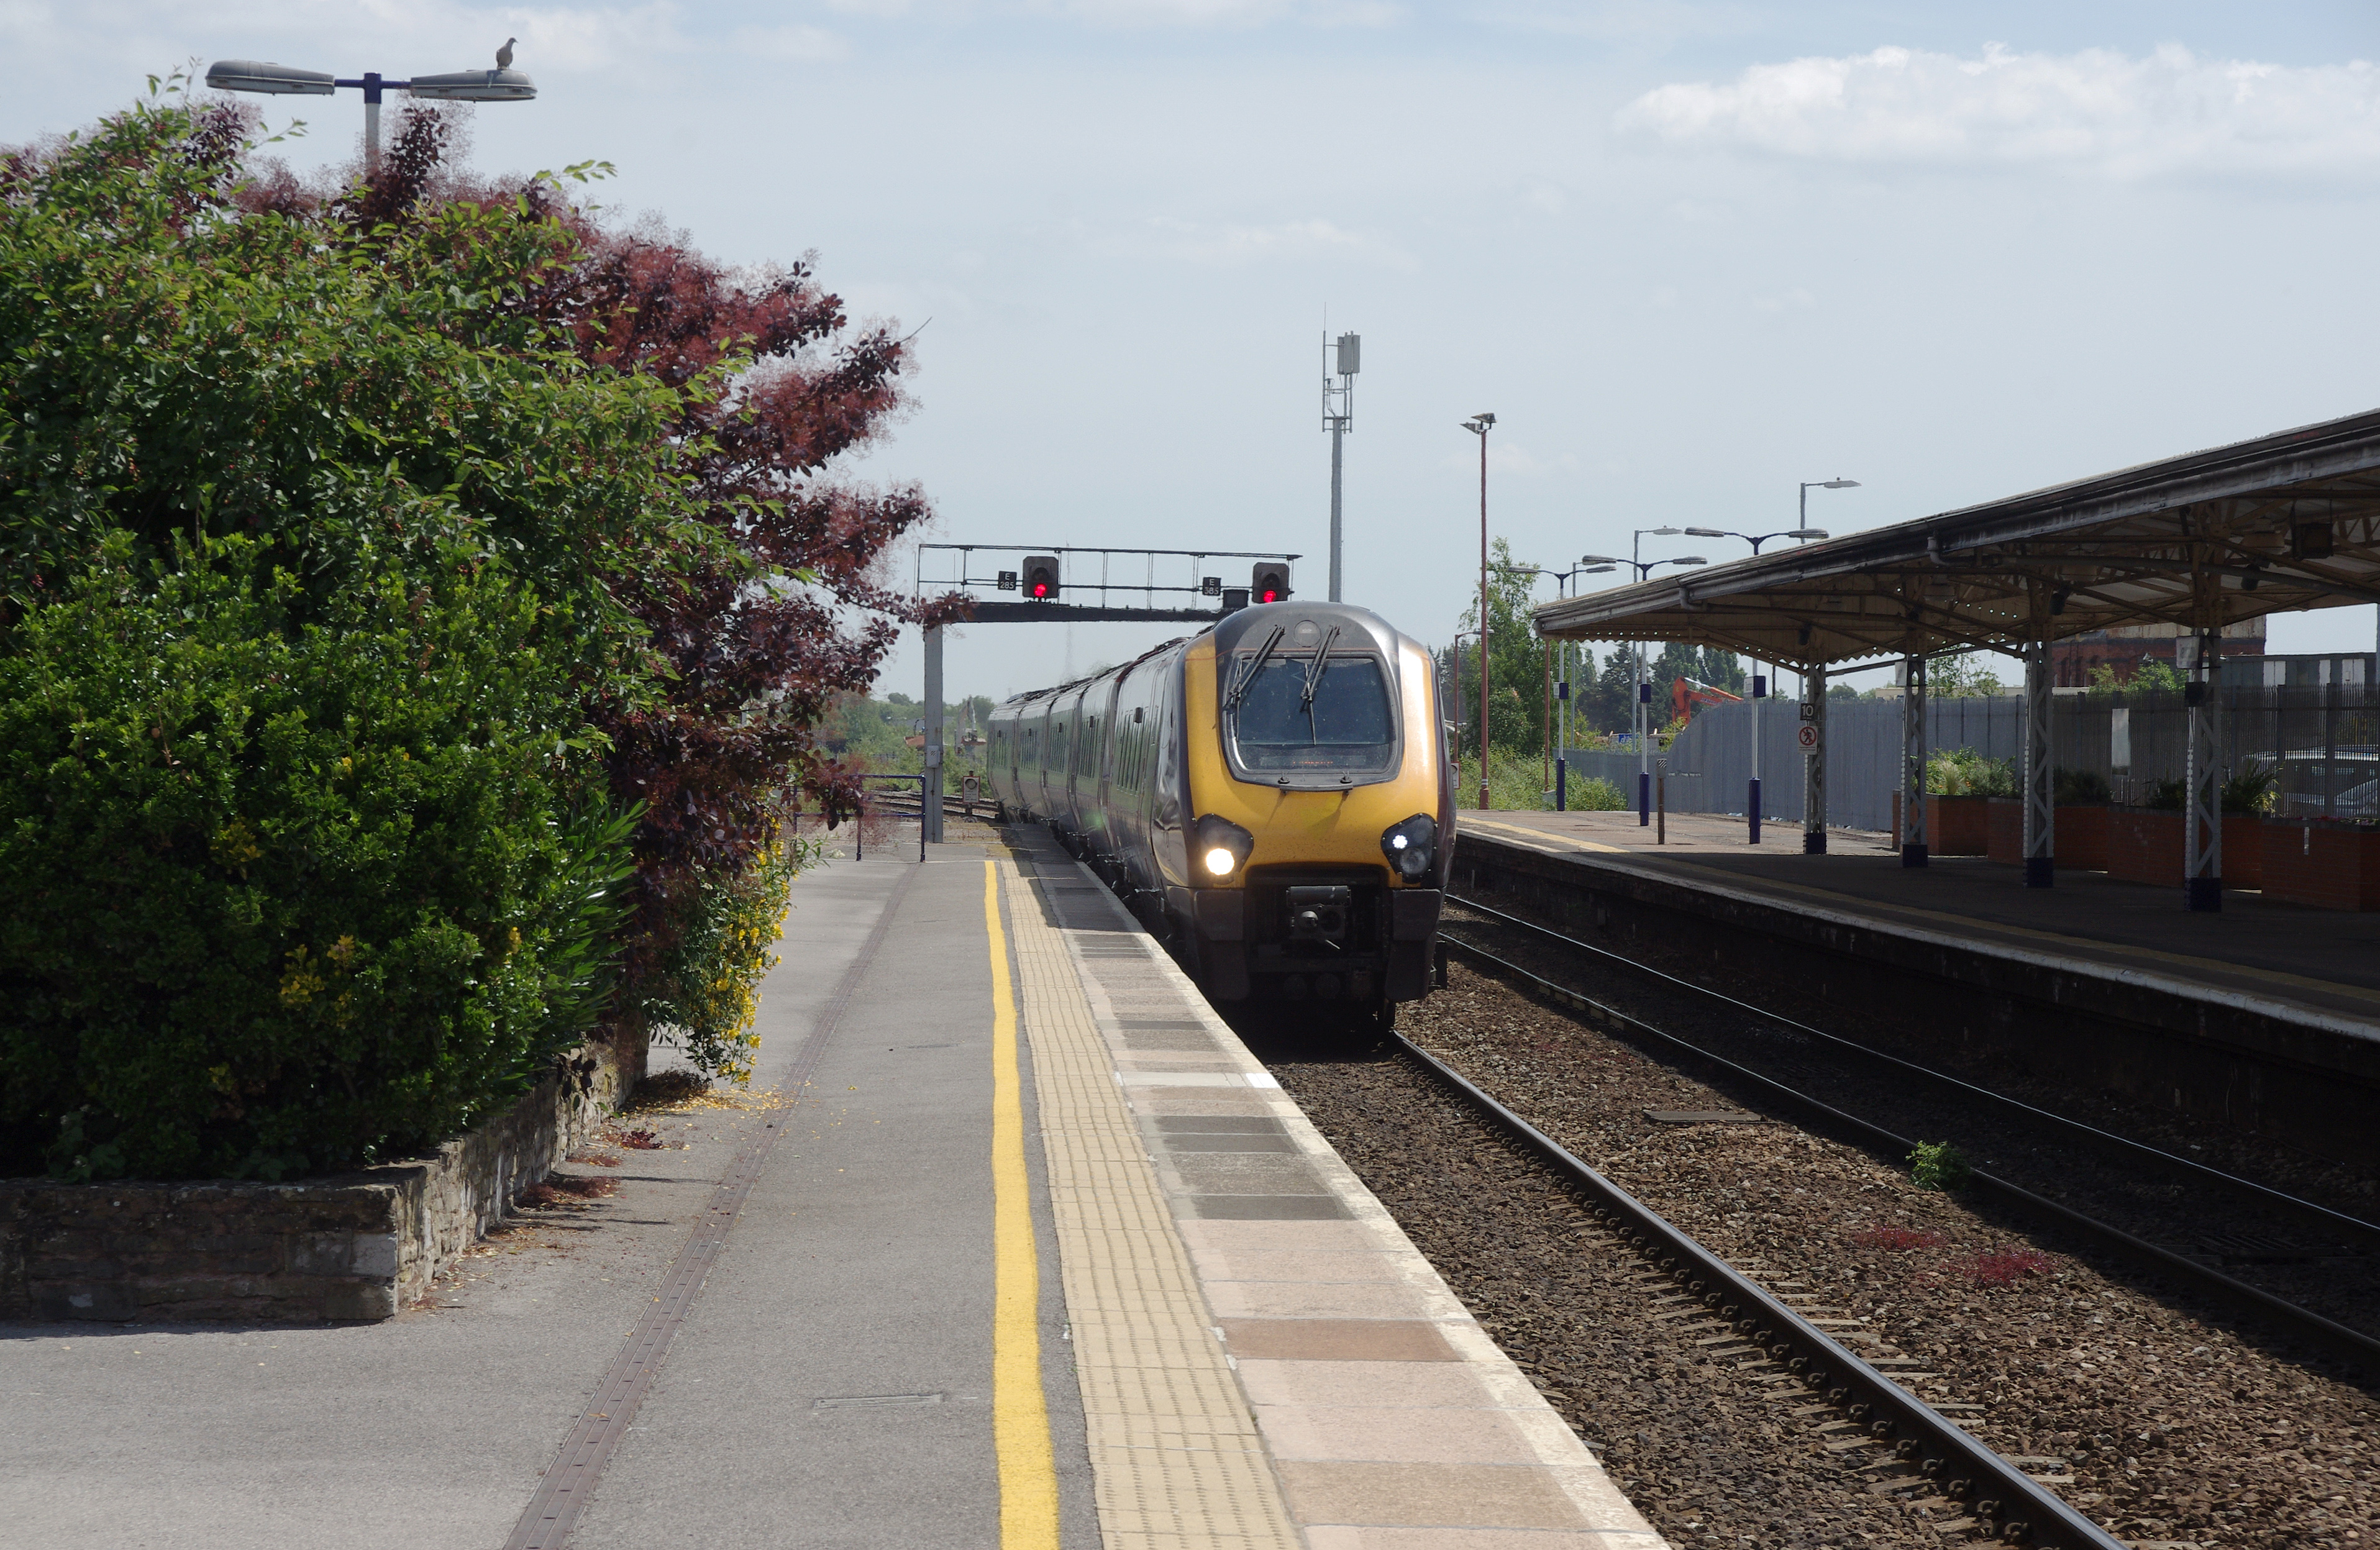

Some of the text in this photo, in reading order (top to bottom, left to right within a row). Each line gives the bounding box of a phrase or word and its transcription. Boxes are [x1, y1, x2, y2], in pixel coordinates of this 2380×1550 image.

[1000, 581, 1014, 590] 285
[1204, 586, 1219, 595] 385
[1802, 704, 1814, 717] 10
